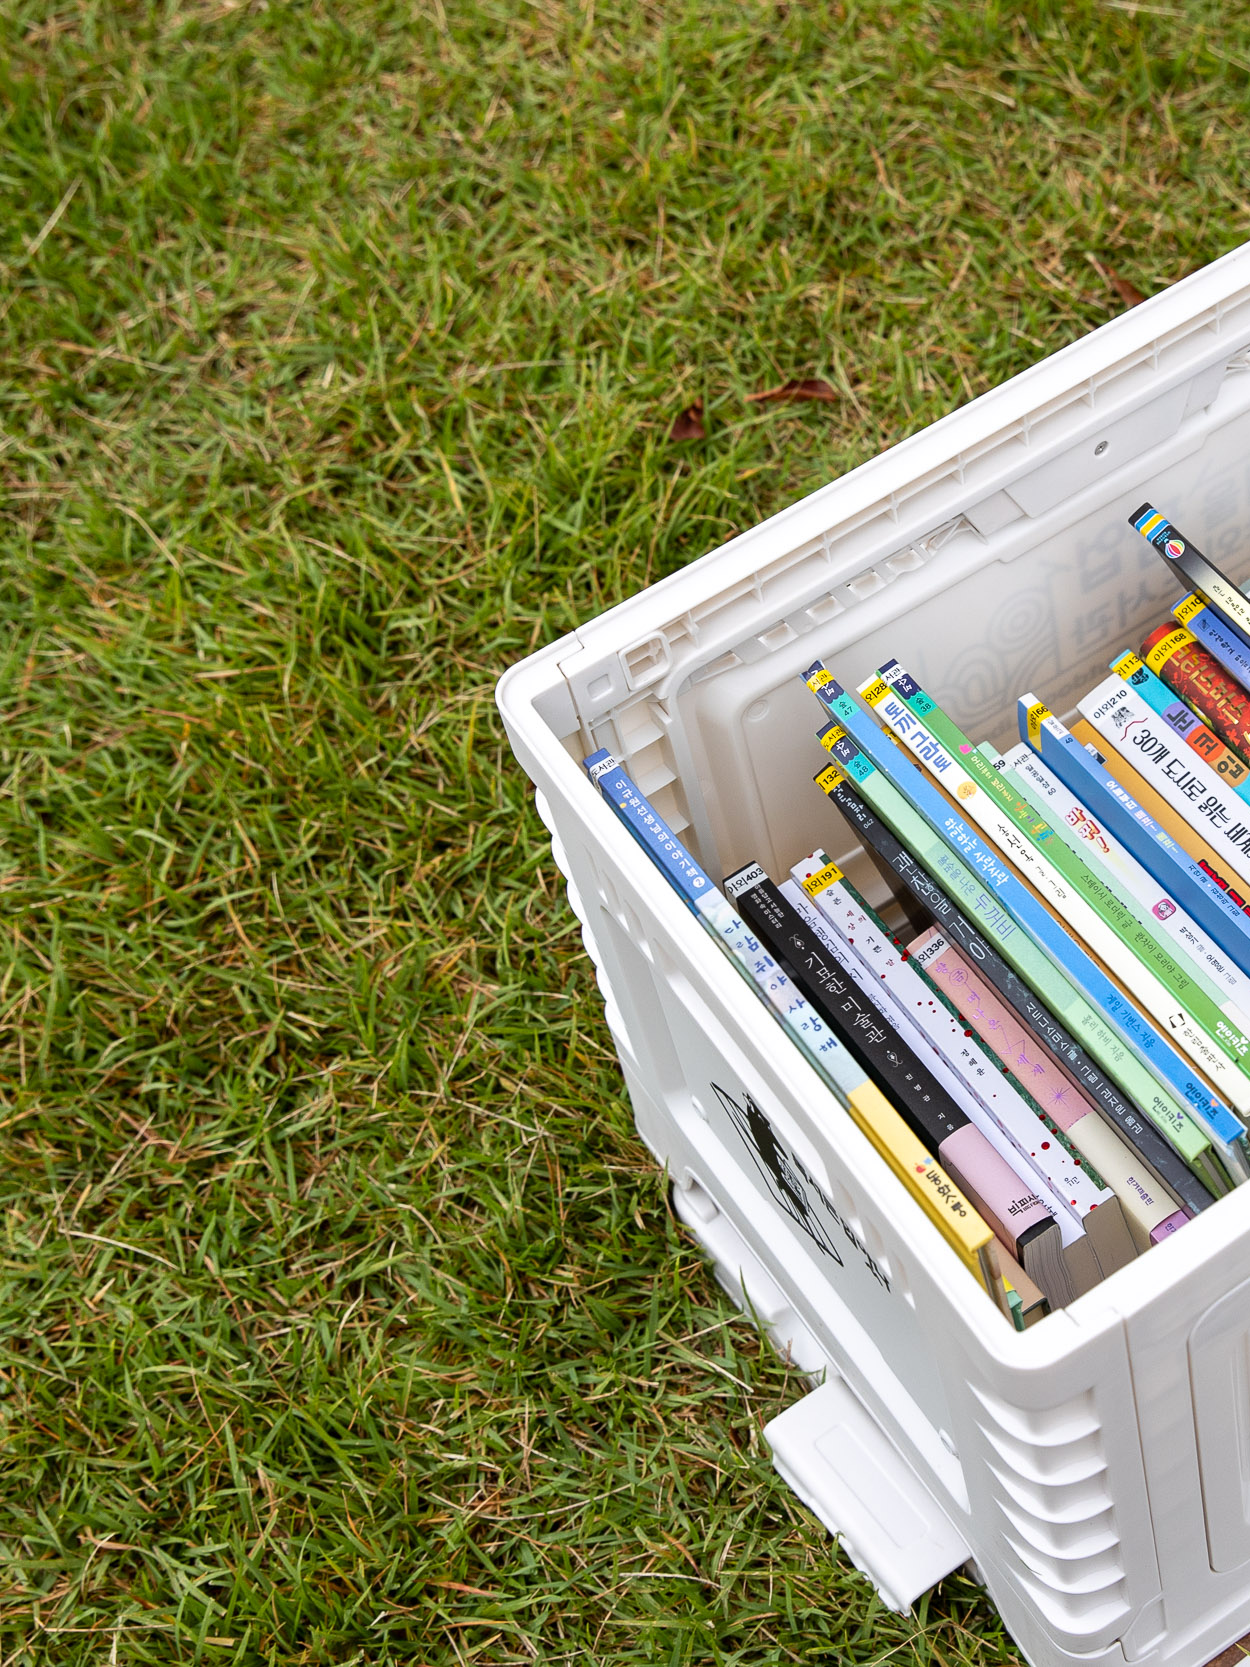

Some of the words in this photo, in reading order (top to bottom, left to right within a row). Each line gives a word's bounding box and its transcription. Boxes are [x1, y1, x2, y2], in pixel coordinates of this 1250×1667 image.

[844, 706, 854, 717] 47
[921, 703, 932, 713] 38
[1169, 642, 1246, 725] 크리스마스
[858, 766, 869, 776] 48
[884, 701, 917, 734] 토끼
[910, 730, 953, 773] 그라토
[818, 769, 839, 790] 132
[1132, 729, 1171, 765] 30개
[1161, 758, 1207, 802] 도시로
[1198, 796, 1231, 829] 읽는
[944, 817, 978, 853] 하늘하늘
[973, 851, 1010, 887] 사락사락
[1065, 806, 1110, 853] 바꿔!
[893, 850, 951, 915] 괜찮을
[949, 915, 993, 960] 거야
[974, 893, 1017, 941] 두꺼비
[724, 919, 788, 990] 다람쥐야
[788, 999, 838, 1052] 사랑해
[805, 951, 847, 994] 기묘한
[841, 996, 887, 1044] 미술관
